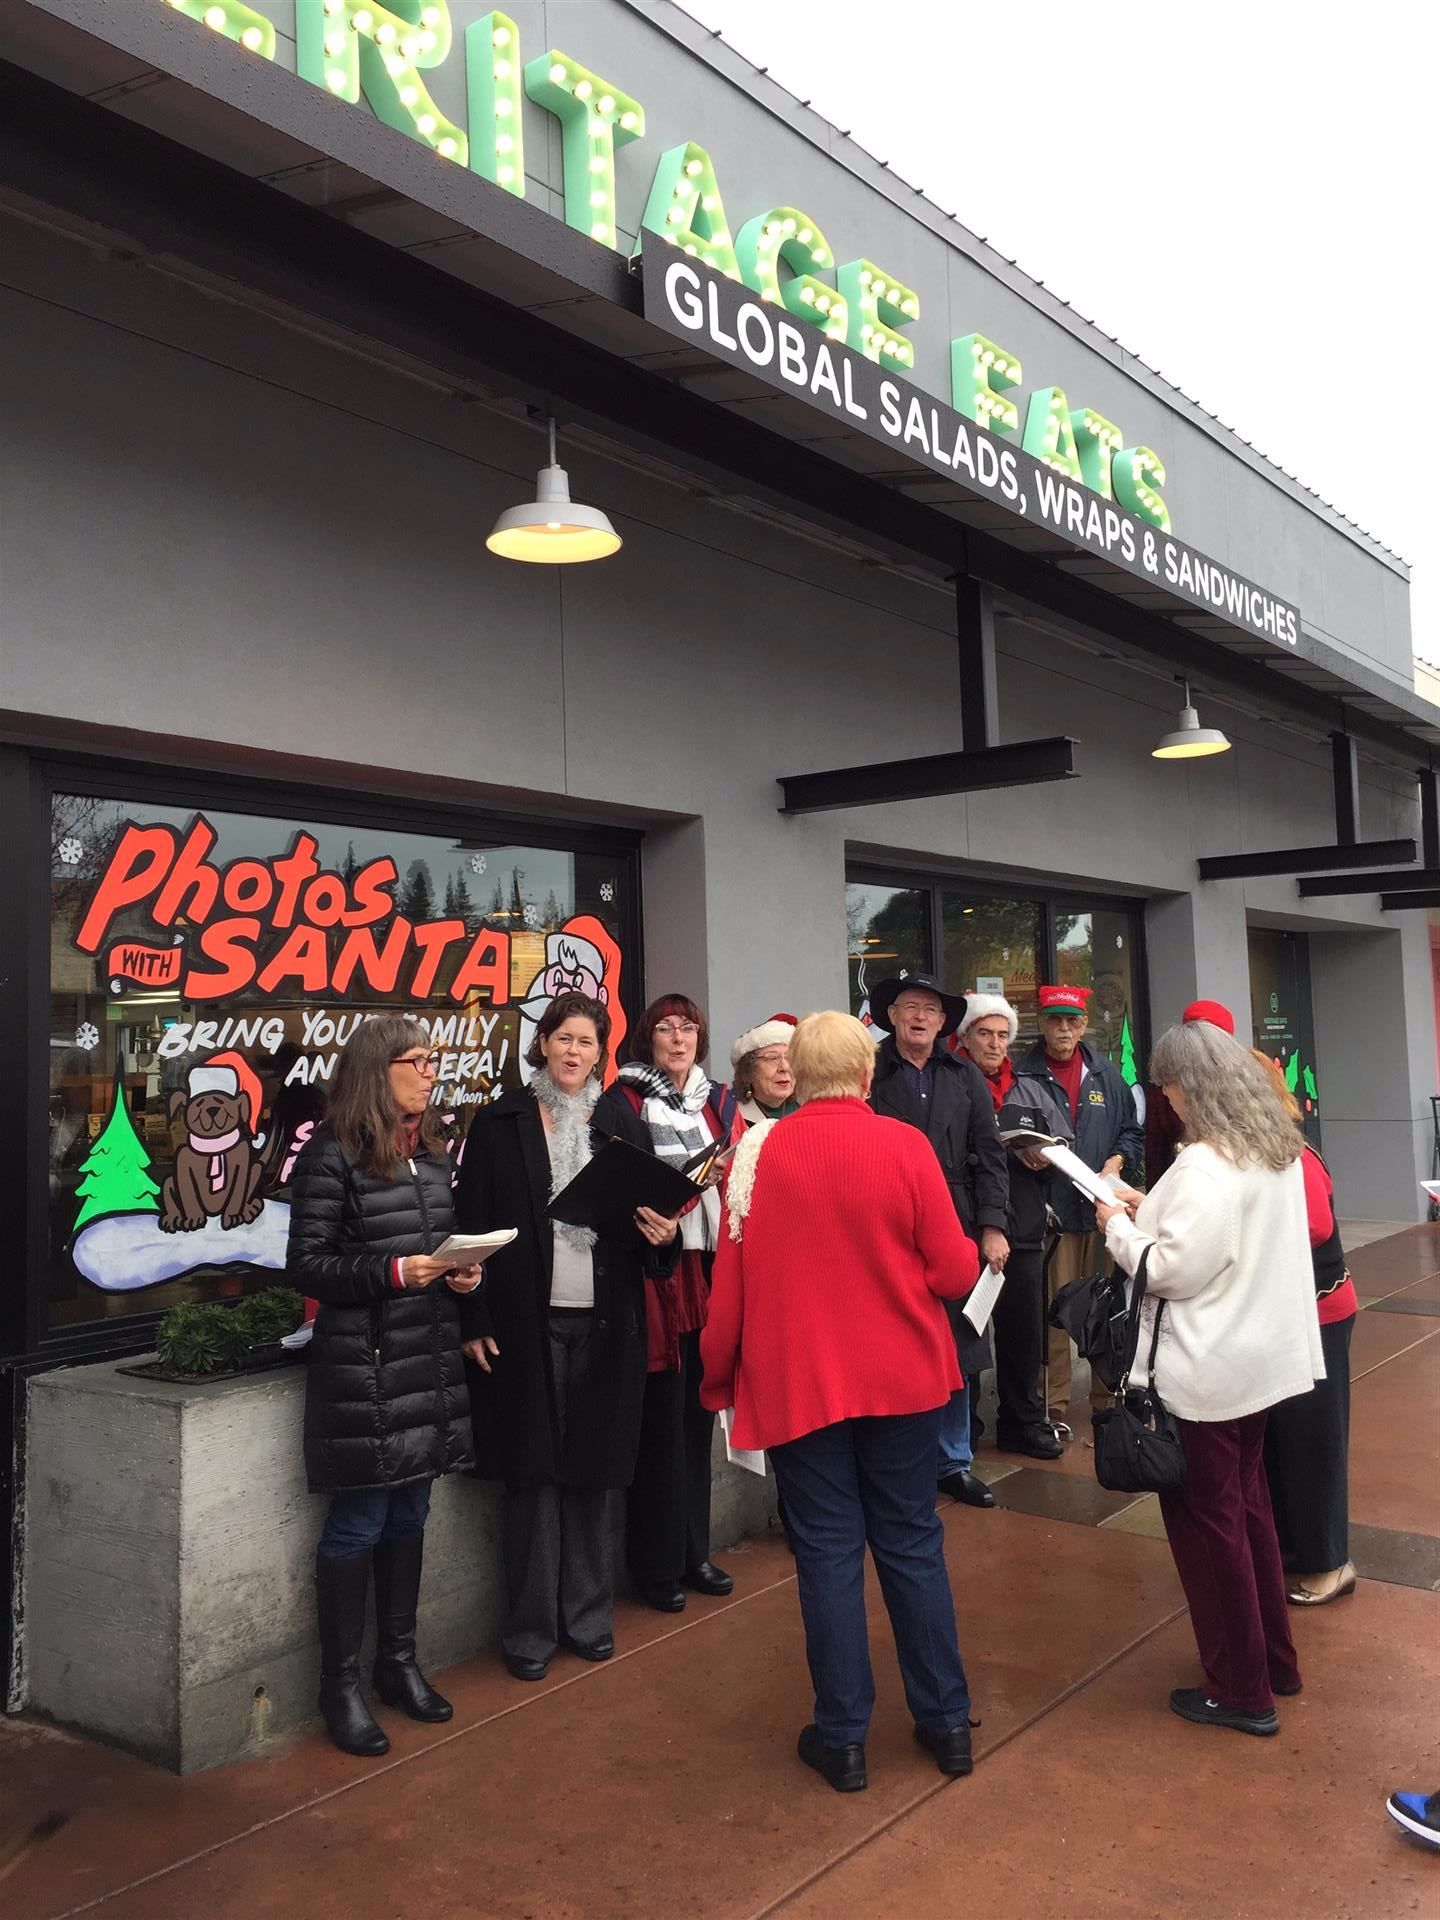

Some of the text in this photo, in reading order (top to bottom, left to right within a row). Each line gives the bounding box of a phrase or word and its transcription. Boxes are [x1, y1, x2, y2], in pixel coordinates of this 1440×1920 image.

[164, 0, 1171, 534] RITAGE EATS
[665, 262, 1297, 645] GLOBAL SALADS, WRAPS & SANDWICHES
[76, 819, 398, 951] Photos
[122, 950, 173, 978] WITH
[183, 918, 510, 1005] SANTA
[157, 1009, 499, 1059] BRING YOU MILY
